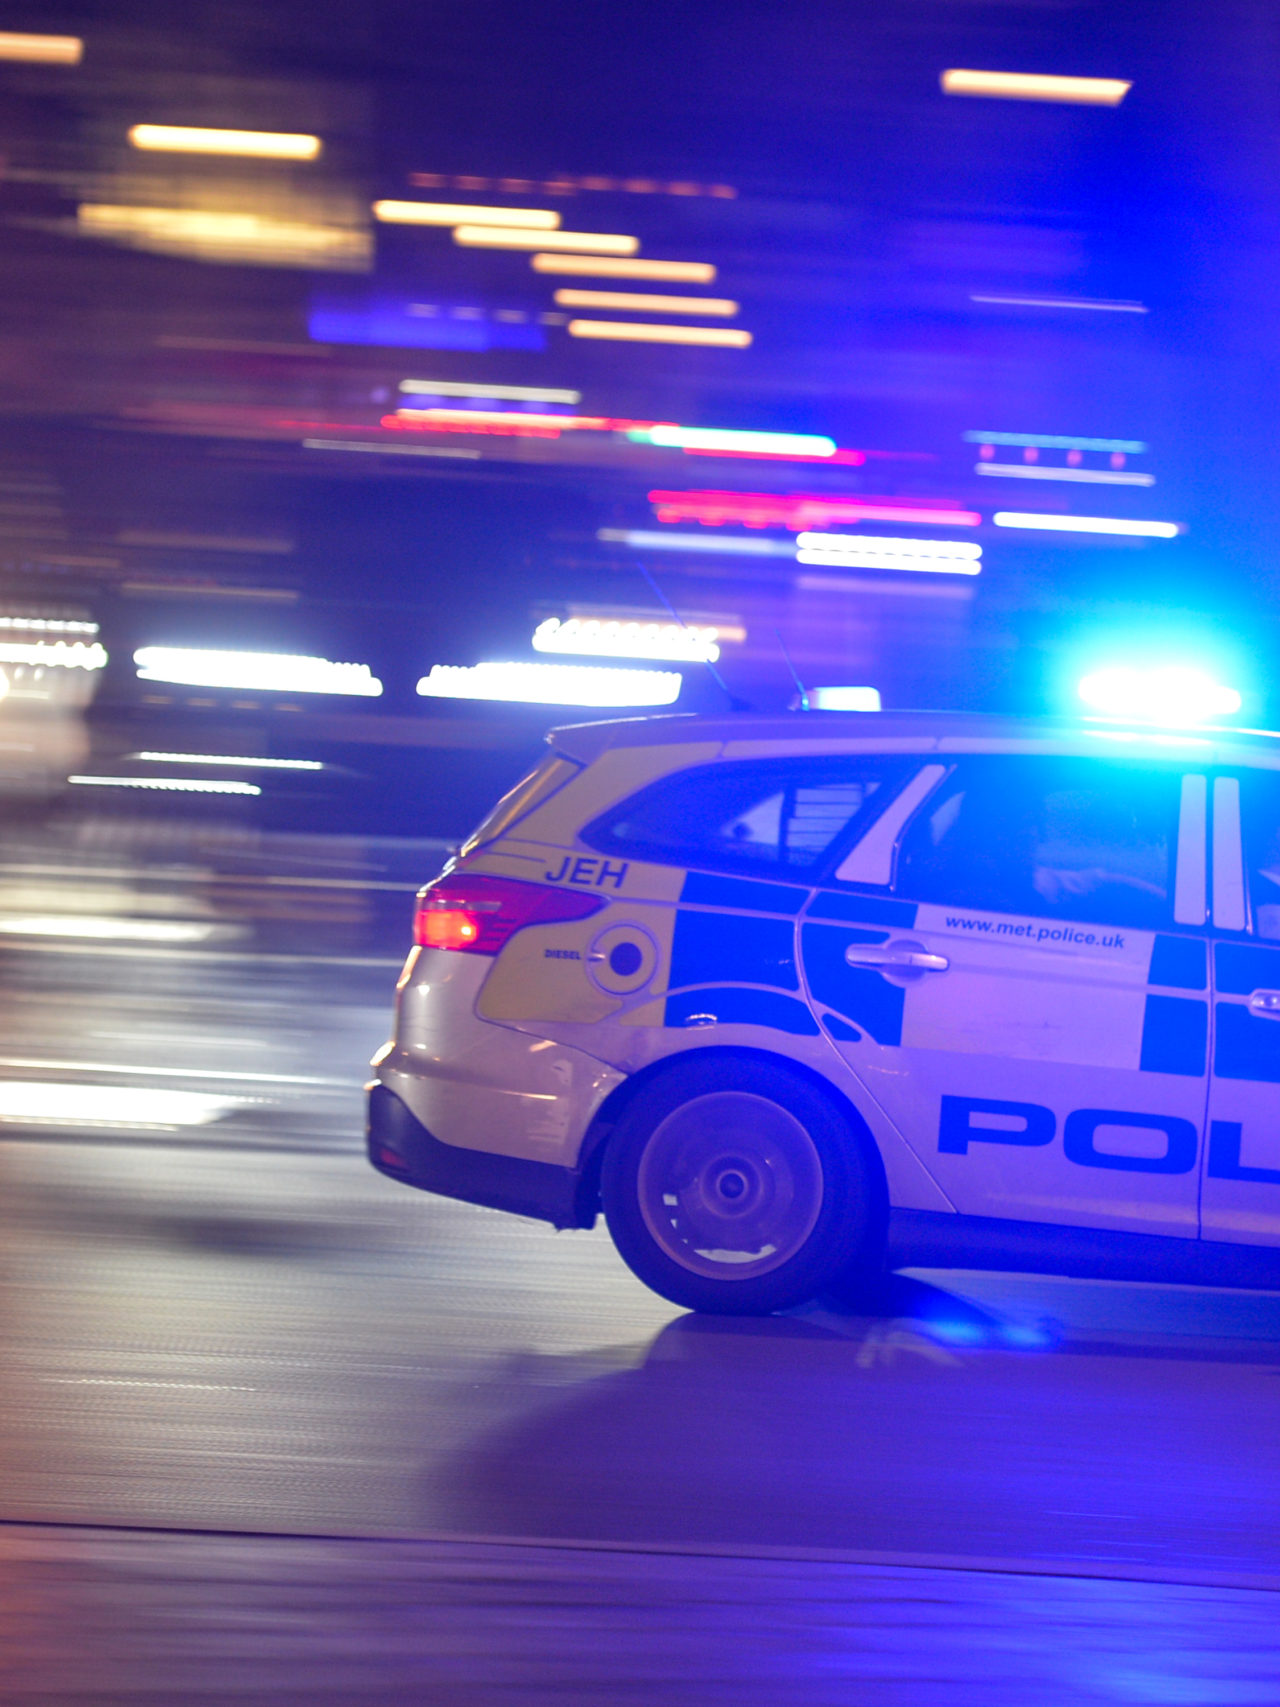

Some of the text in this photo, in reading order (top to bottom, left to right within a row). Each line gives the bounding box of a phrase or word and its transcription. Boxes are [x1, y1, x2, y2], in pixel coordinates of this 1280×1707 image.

[545, 857, 628, 888] JEH
[945, 915, 1125, 949] www.met.police.uk
[545, 949, 582, 961] DIESEL
